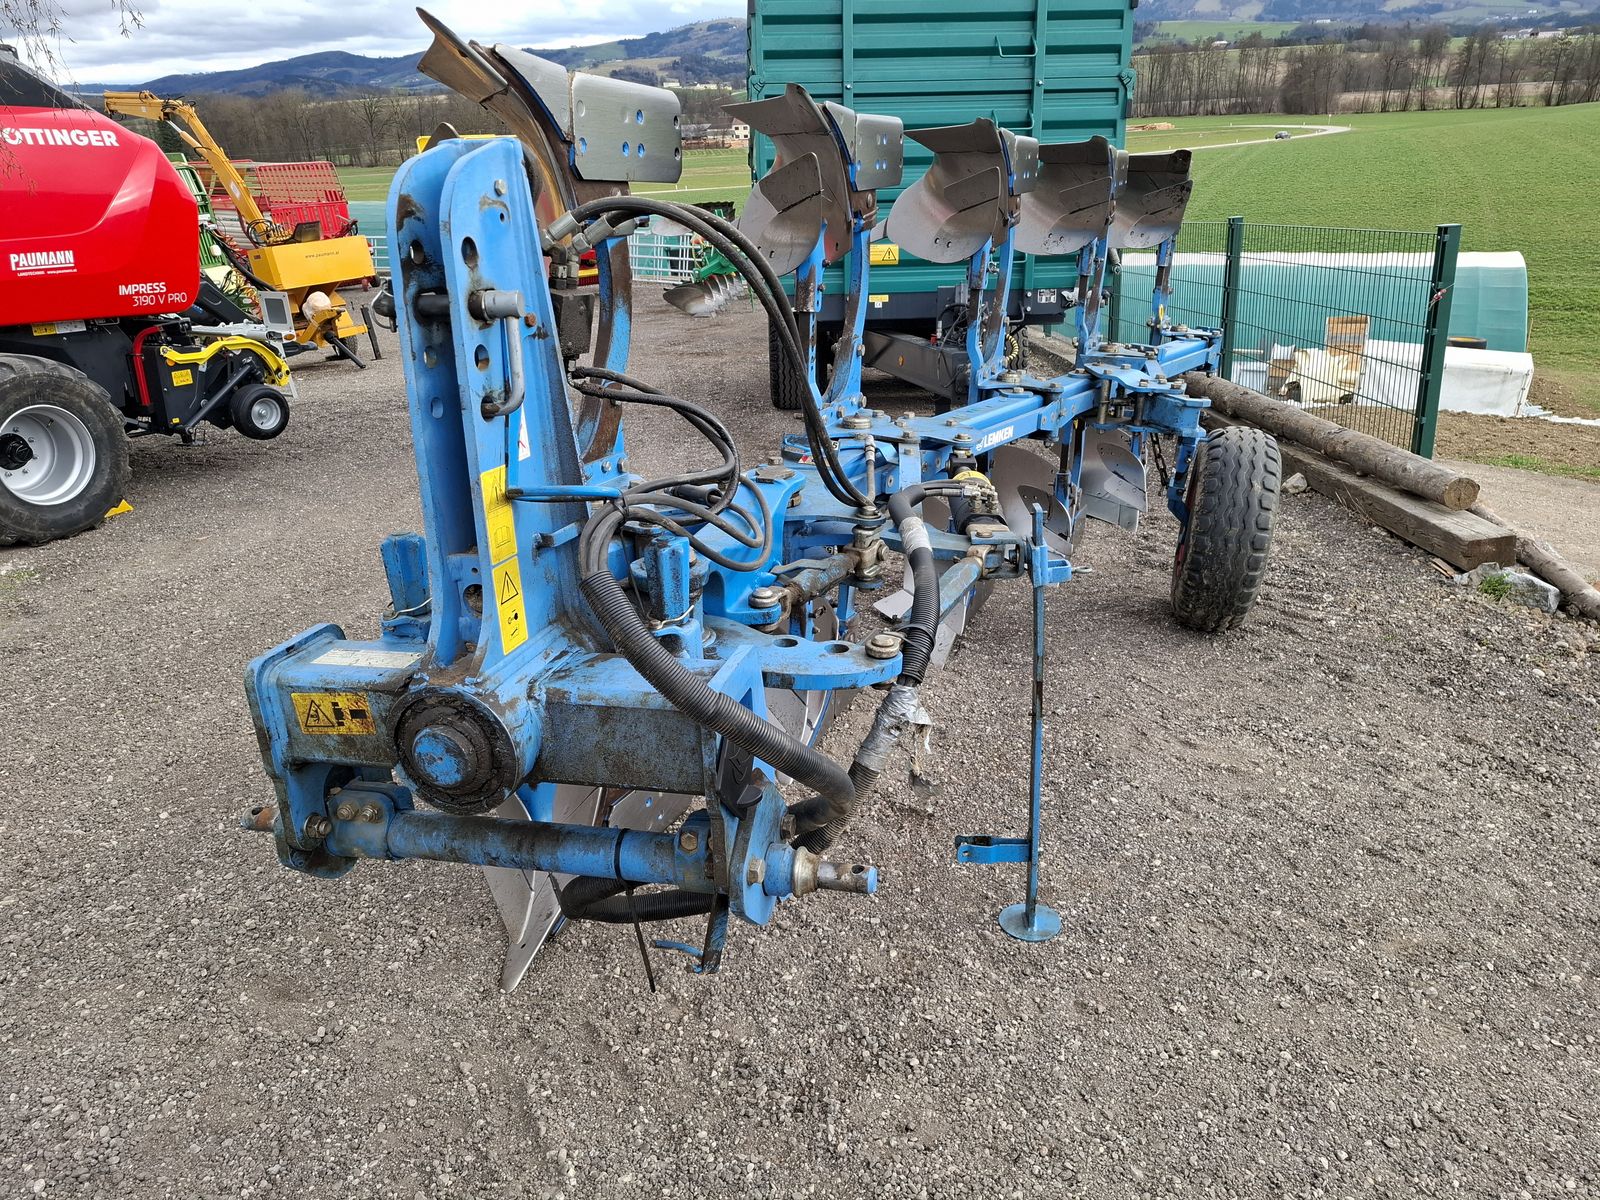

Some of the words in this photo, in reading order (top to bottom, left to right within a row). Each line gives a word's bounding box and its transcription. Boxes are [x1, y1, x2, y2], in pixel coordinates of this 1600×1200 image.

[0, 127, 120, 147] ÖTTINGER
[9, 250, 75, 271] PAUMANN
[118, 281, 167, 296] IMPRESS
[132, 294, 156, 307] 3190
[157, 294, 166, 305] V
[167, 291, 188, 304] PRO
[984, 425, 1014, 447] LEMKEN
